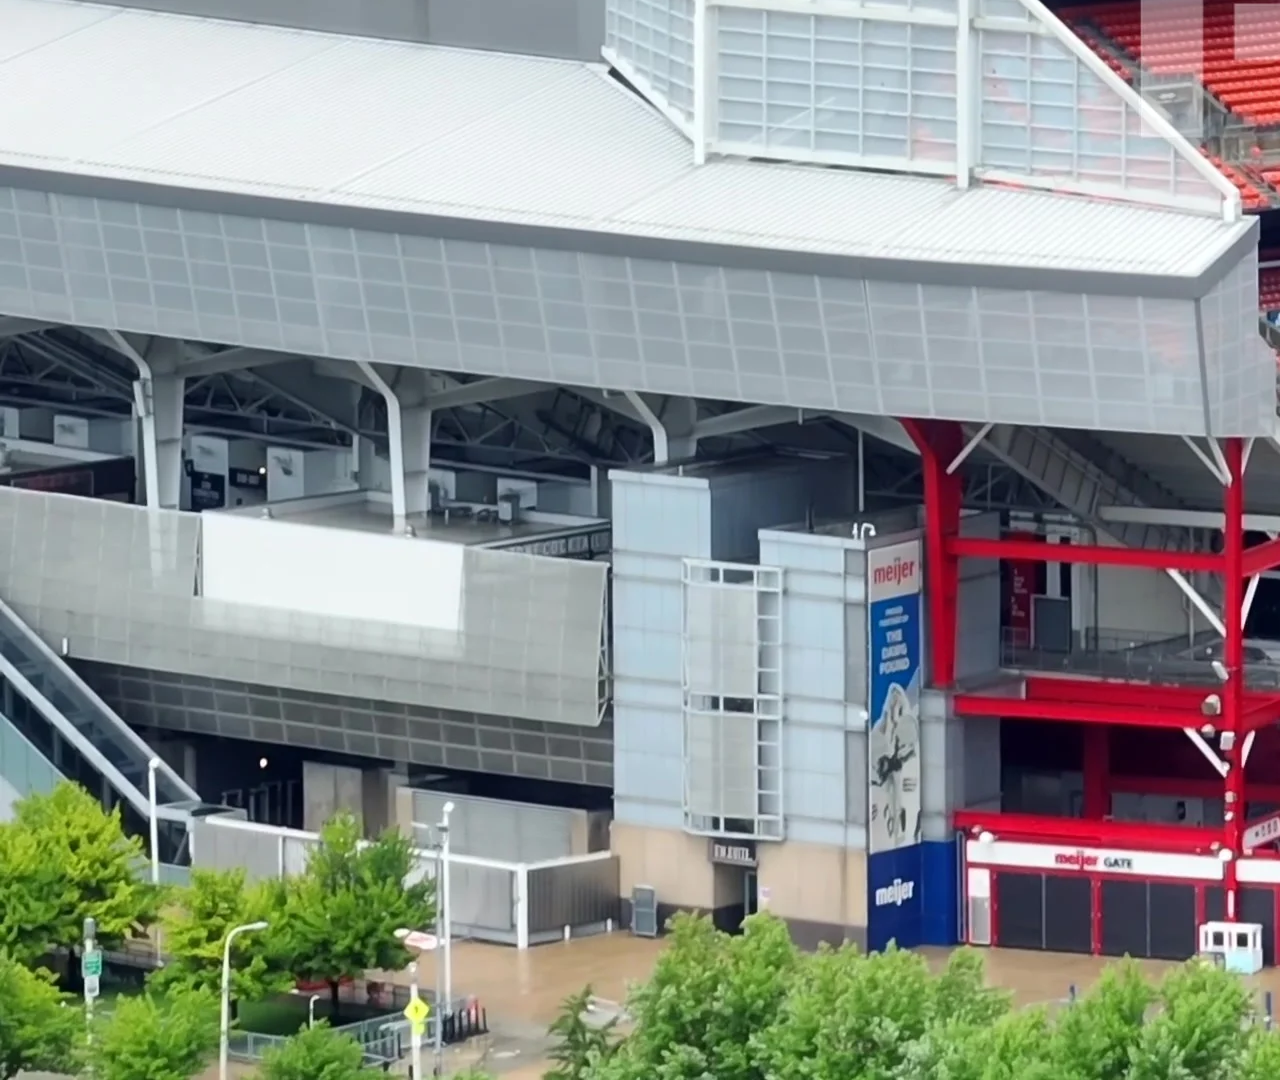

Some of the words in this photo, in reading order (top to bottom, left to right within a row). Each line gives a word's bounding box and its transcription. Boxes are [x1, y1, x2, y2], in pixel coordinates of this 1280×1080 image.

[874, 557, 915, 585] meijer
[1055, 850, 1099, 870] meijer
[1103, 857, 1133, 869] GATE
[875, 878, 914, 906] meijer
